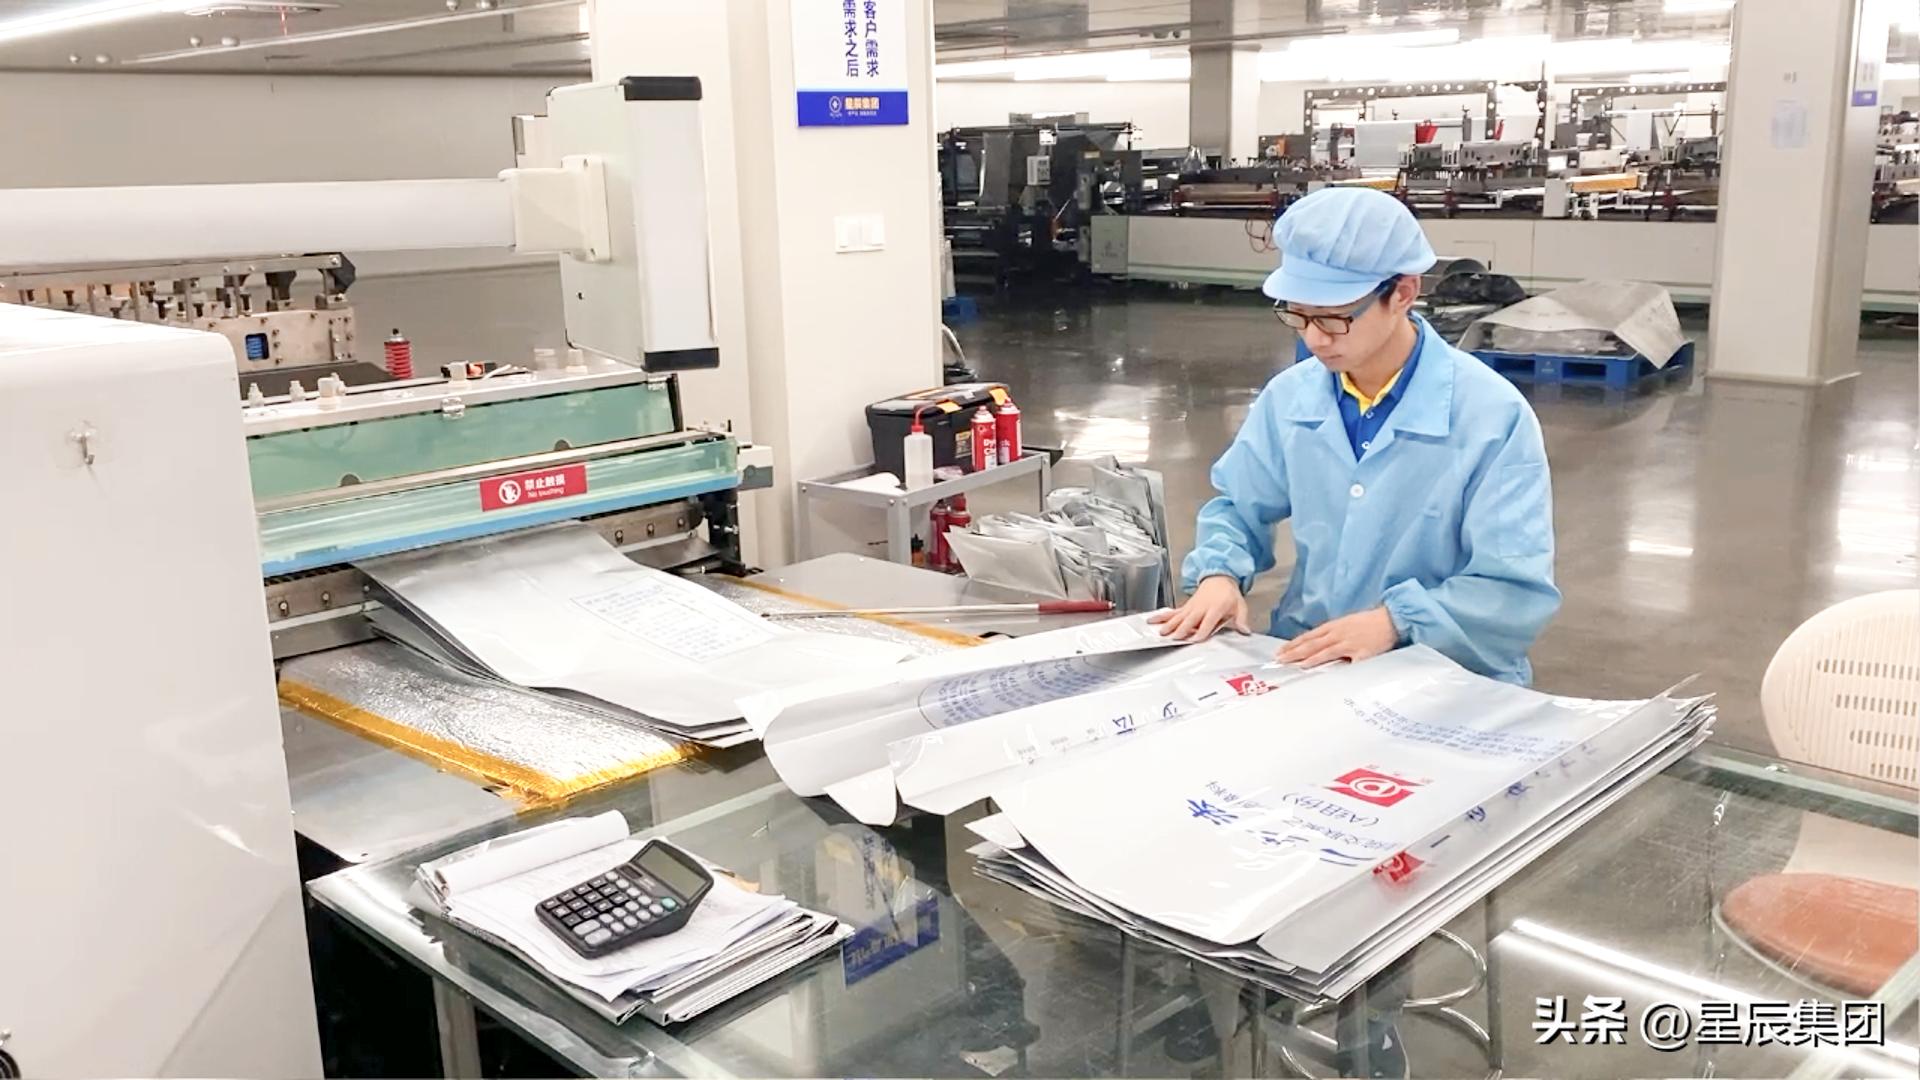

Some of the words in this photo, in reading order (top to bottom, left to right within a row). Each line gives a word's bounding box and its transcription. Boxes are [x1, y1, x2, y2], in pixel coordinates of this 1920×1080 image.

[843, 0, 859, 77] 需求之后
[864, 0, 879, 77] 客户需求
[528, 490, 537, 498] No
